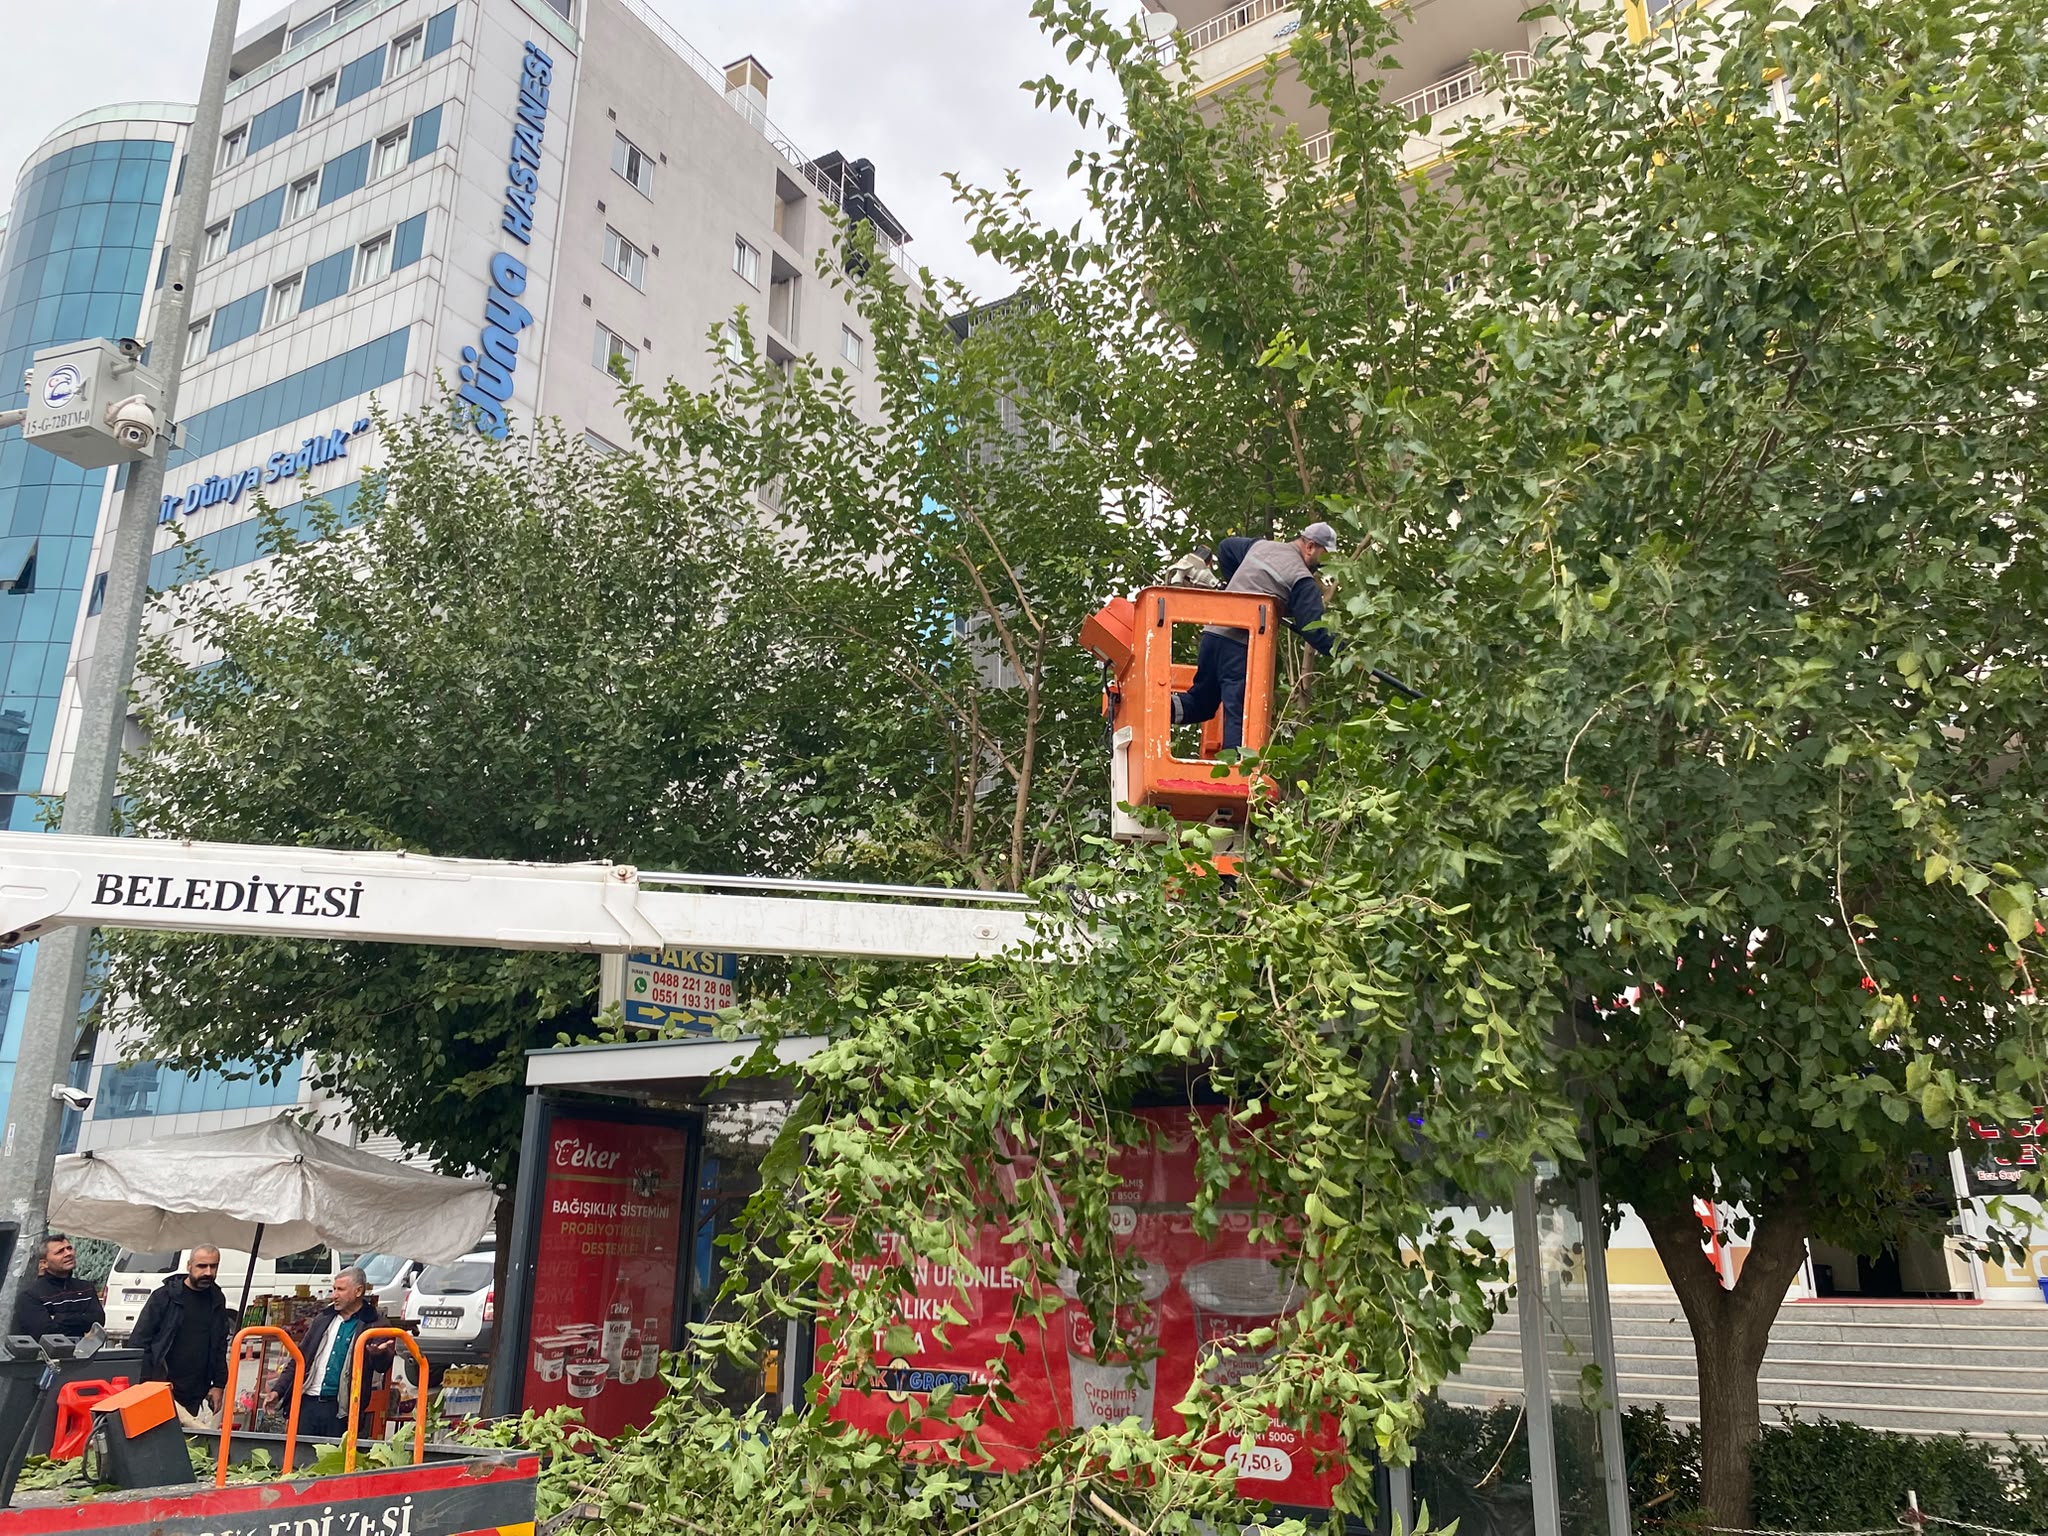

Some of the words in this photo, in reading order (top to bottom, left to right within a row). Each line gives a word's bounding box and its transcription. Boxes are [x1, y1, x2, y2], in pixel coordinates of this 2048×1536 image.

[501, 41, 554, 245] HASTANESİ
[183, 465, 261, 516] Dünya
[91, 873, 365, 918] BELEDİYESİ
[652, 970, 679, 988] 0488
[682, 976, 701, 992] 221
[704, 980, 717, 994] 28
[719, 983, 731, 997] 08
[651, 988, 678, 1005] 0551
[682, 992, 701, 1008] 193
[704, 997, 715, 1010] 31
[552, 1198, 617, 1218] BAĞIŞIKLIK
[1084, 1381, 1138, 1401] Çırpılmış
[1090, 1401, 1131, 1420] Yoğurt
[1268, 1431, 1295, 1443] 500G
